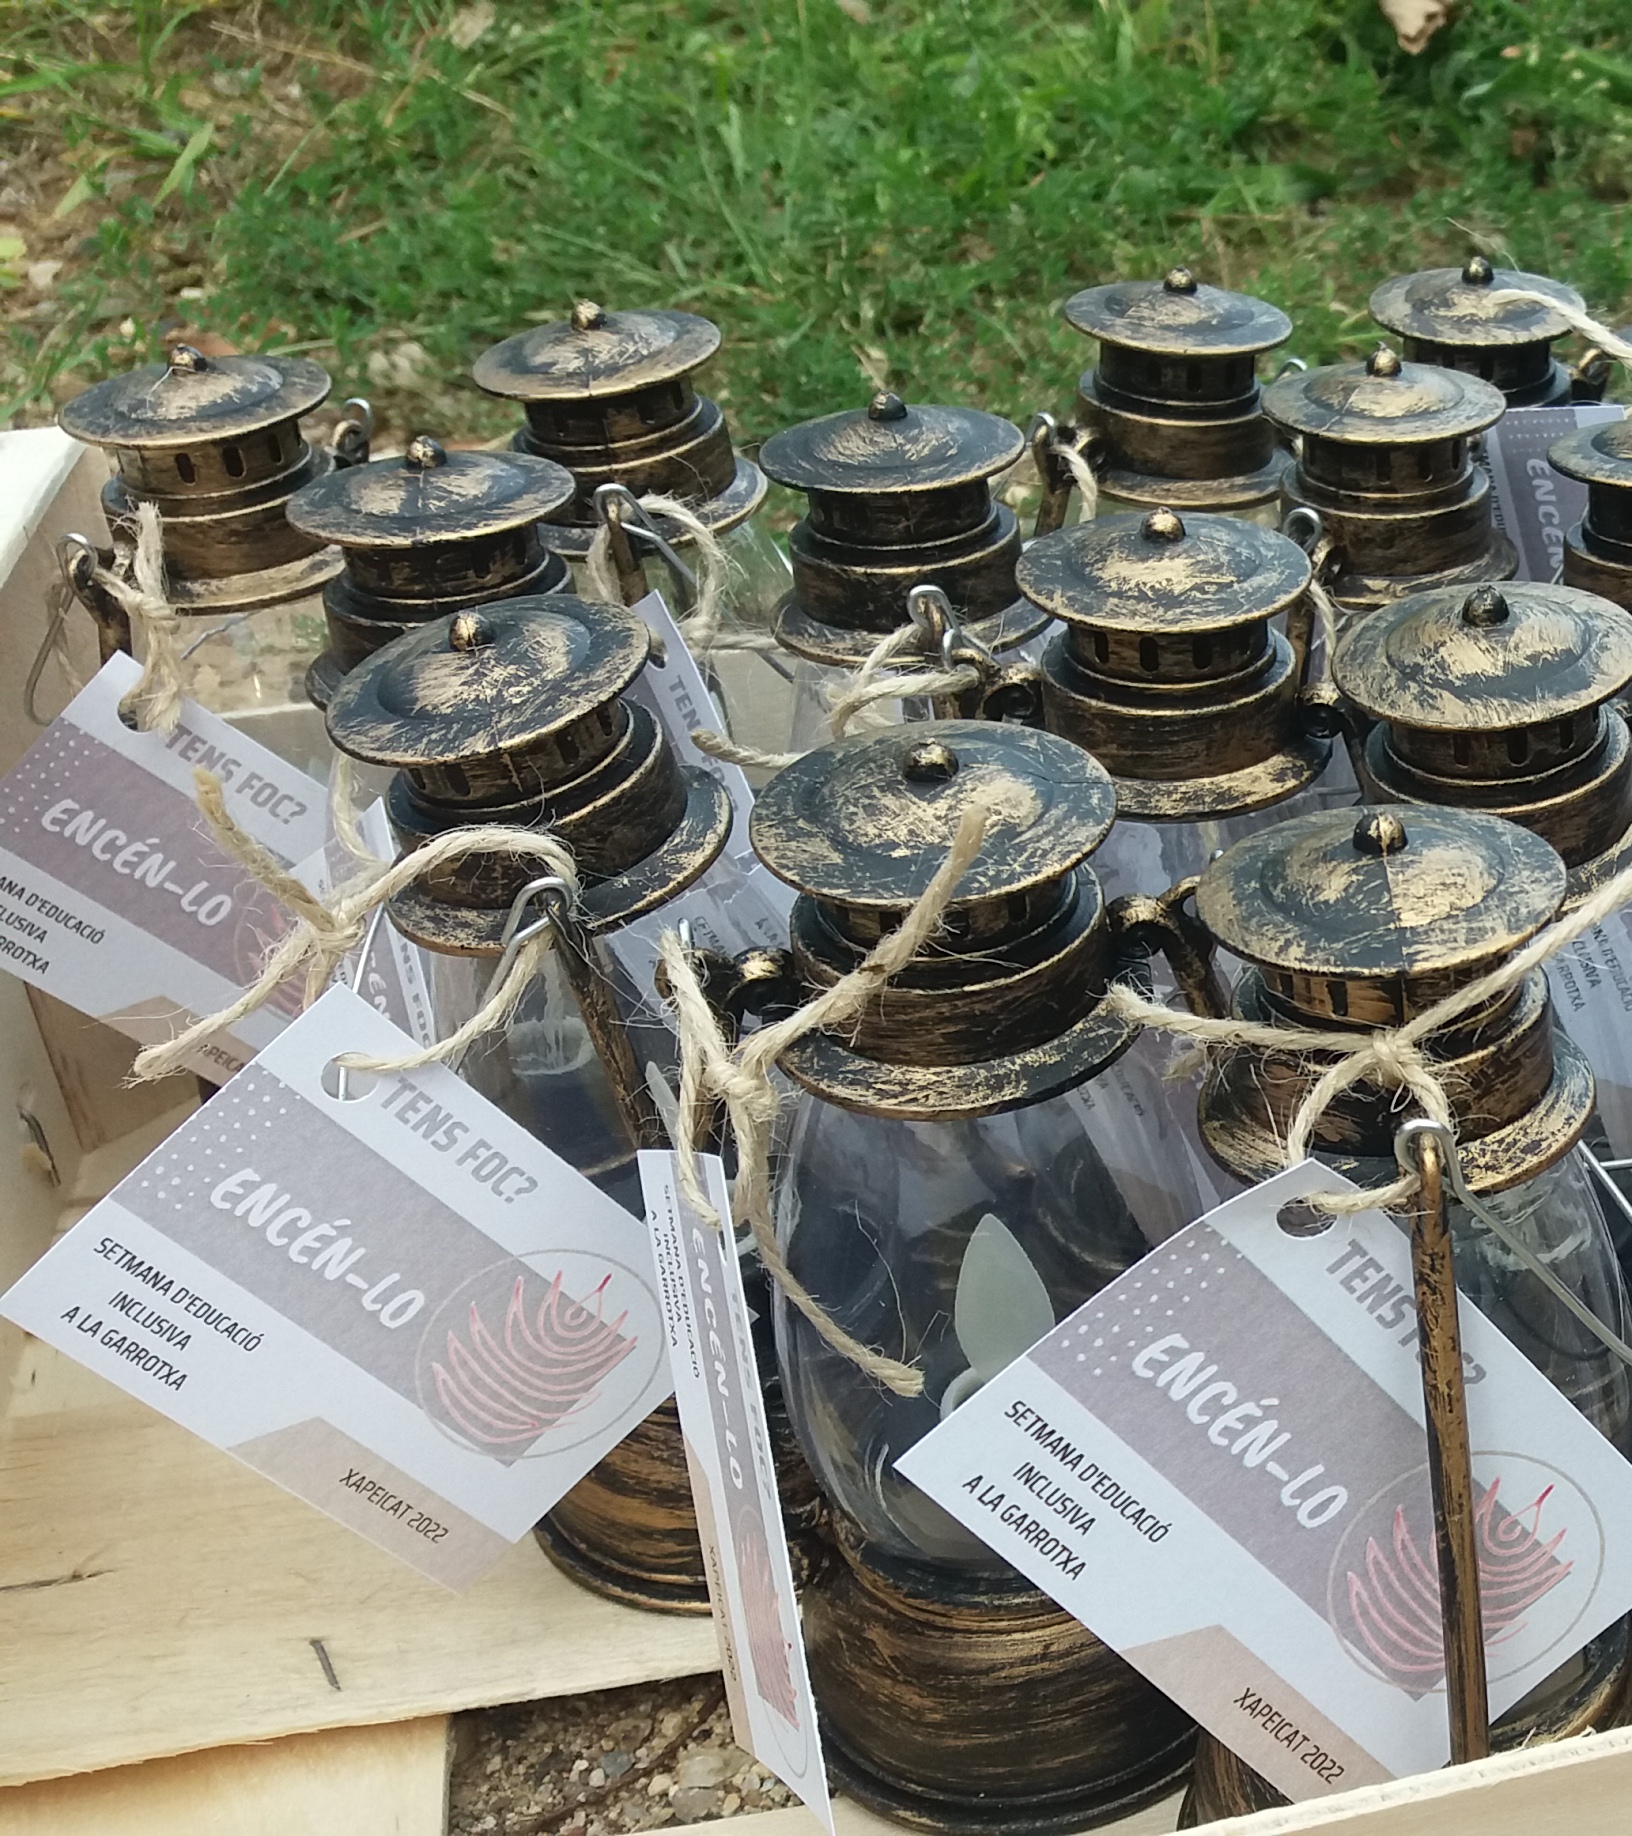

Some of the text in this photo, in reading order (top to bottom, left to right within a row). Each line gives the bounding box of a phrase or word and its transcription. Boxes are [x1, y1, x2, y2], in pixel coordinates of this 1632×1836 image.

[669, 675, 702, 731] TEN
[235, 771, 307, 825] FOC?
[41, 798, 232, 927] ENCÉN-LO
[25, 893, 106, 945] D'EDUCACIÓ
[380, 1076, 470, 1152] TENS
[455, 1138, 538, 1204] FOC?
[210, 1168, 425, 1329] ENCÉN-LO
[1325, 1238, 1417, 1330] TENS
[93, 1237, 265, 1352] SETMANA D'EDUCACIÓ
[108, 1290, 192, 1351] INCLUSIVA
[60, 1306, 188, 1391] A LA GARROTXA
[1004, 1400, 1173, 1543] SETMANA D'EDUCACIÓ
[1132, 1332, 1351, 1529] ENCÉN-LO
[339, 1468, 449, 1544] XAPEICAT 2022
[962, 1475, 1087, 1581] A LA GARROTXA
[1012, 1462, 1096, 1536] INCLUSIVA
[1233, 1687, 1345, 1785] XAPEICAT 2022
